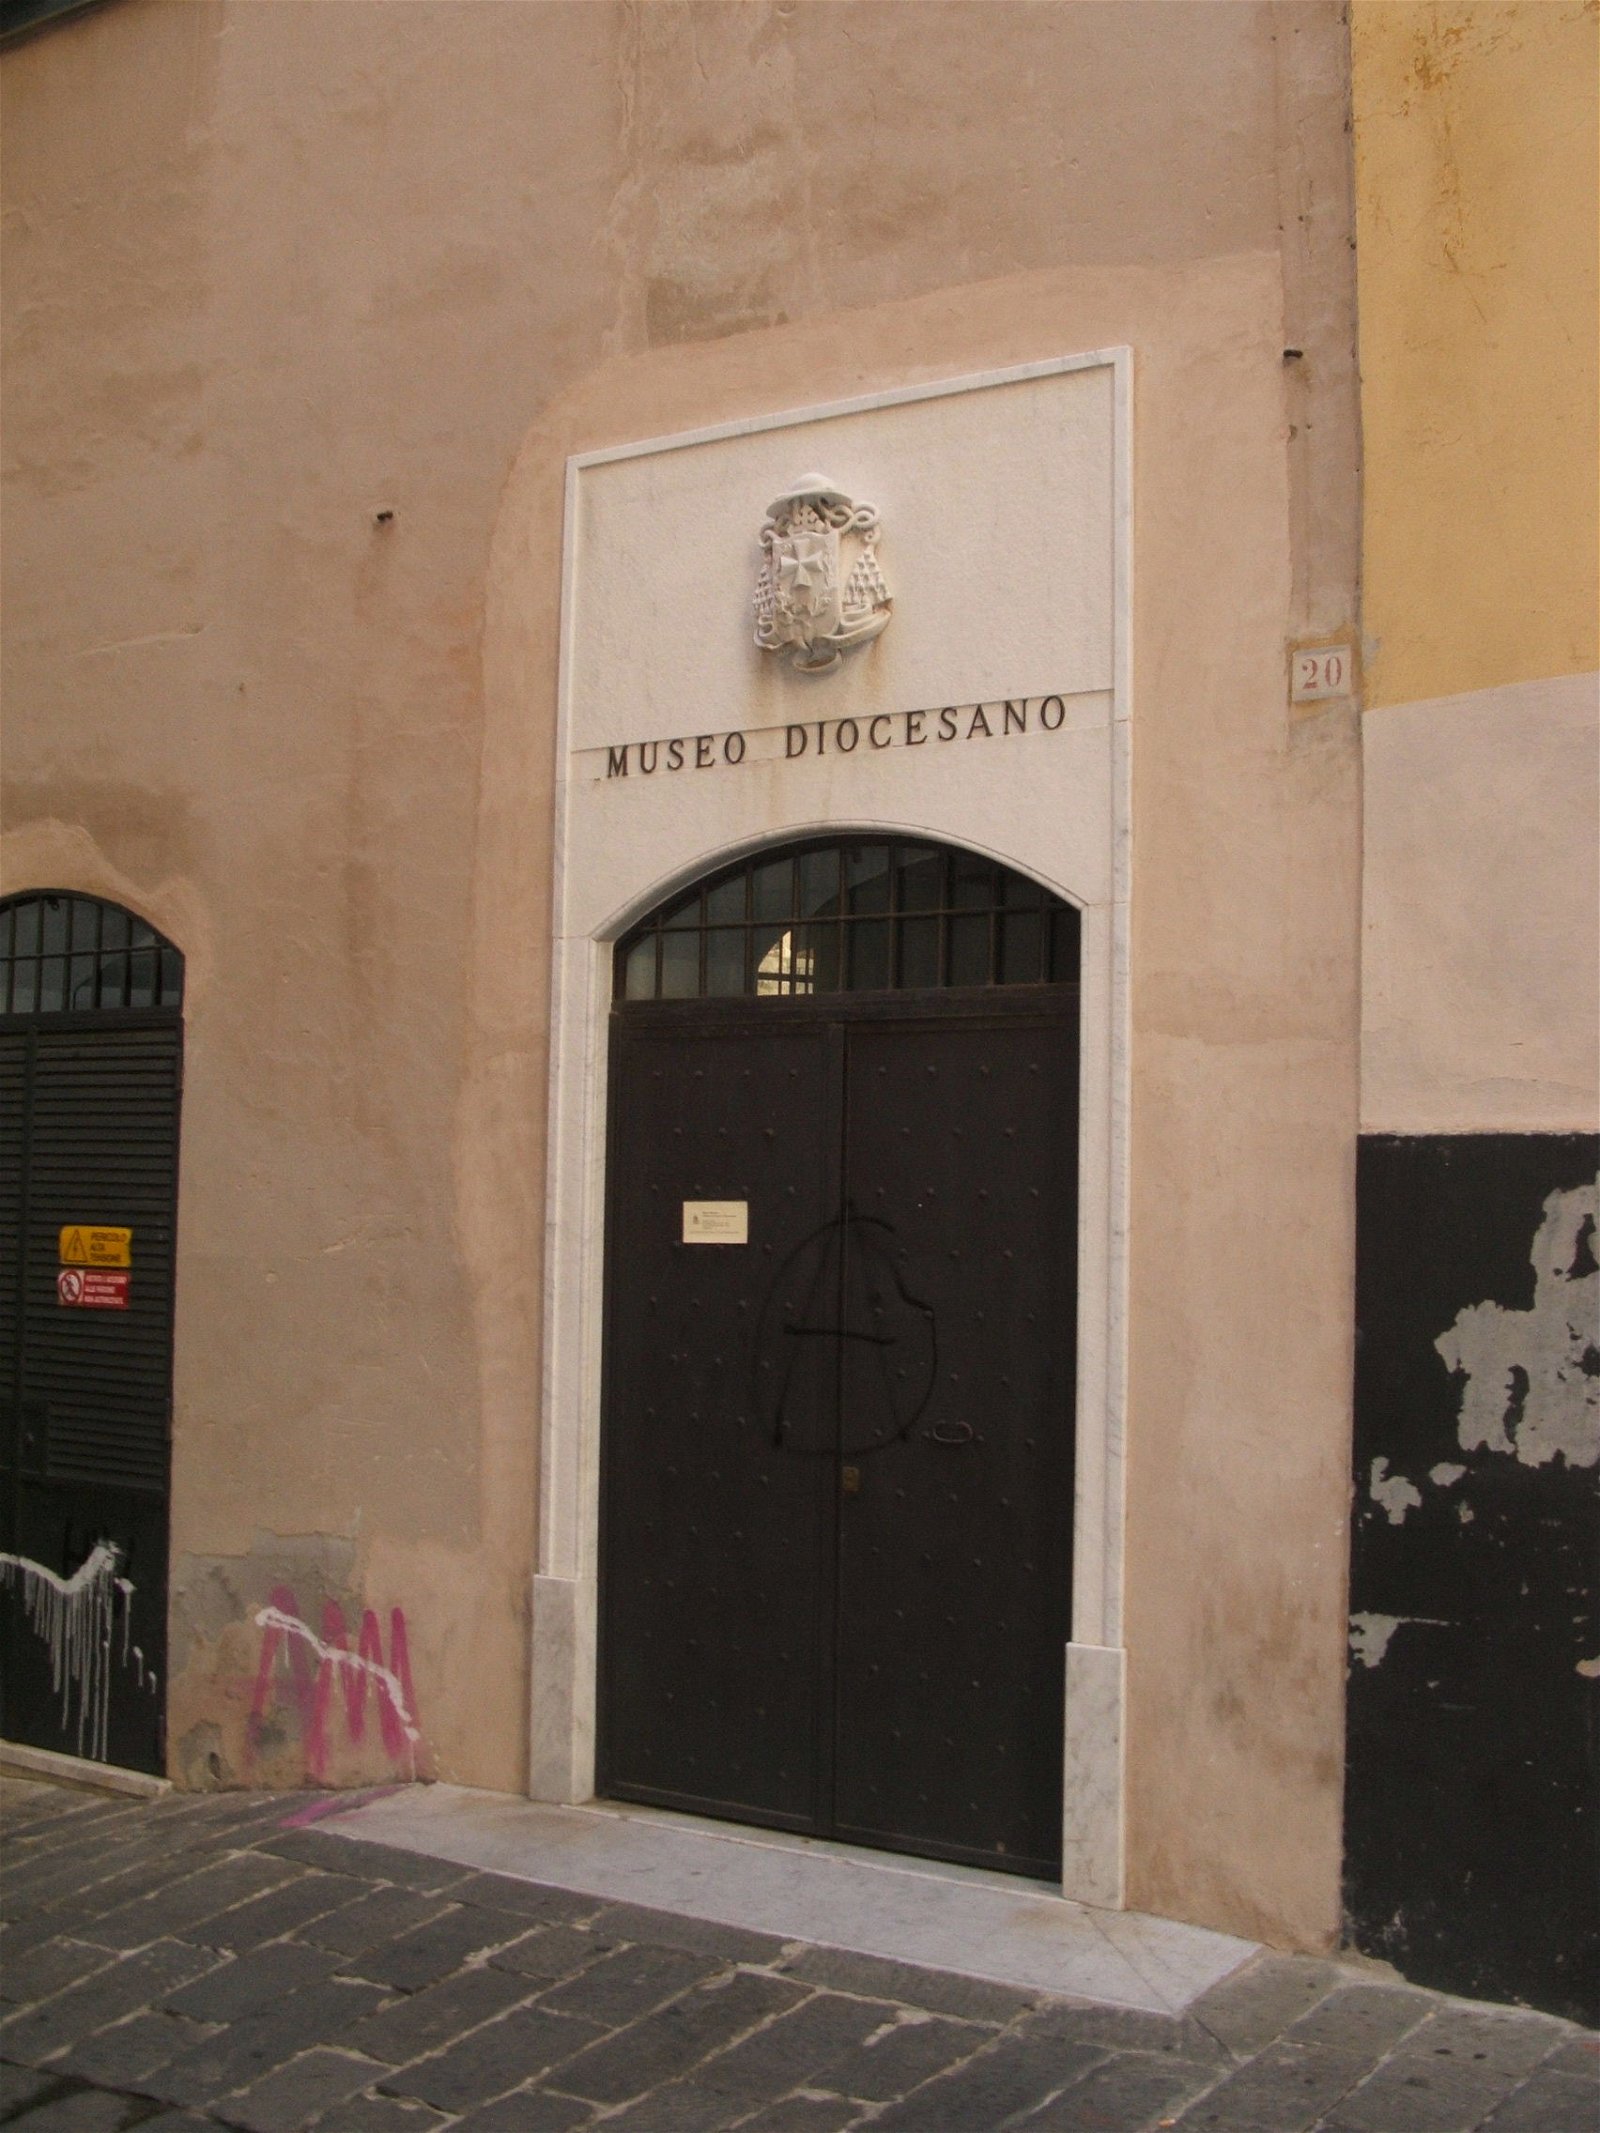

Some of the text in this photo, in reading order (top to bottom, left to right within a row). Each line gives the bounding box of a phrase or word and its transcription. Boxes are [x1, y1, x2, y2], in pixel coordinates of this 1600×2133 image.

[1302, 656, 1341, 689] 20
[606, 695, 1066, 778] MUSEO DIOCESANO
